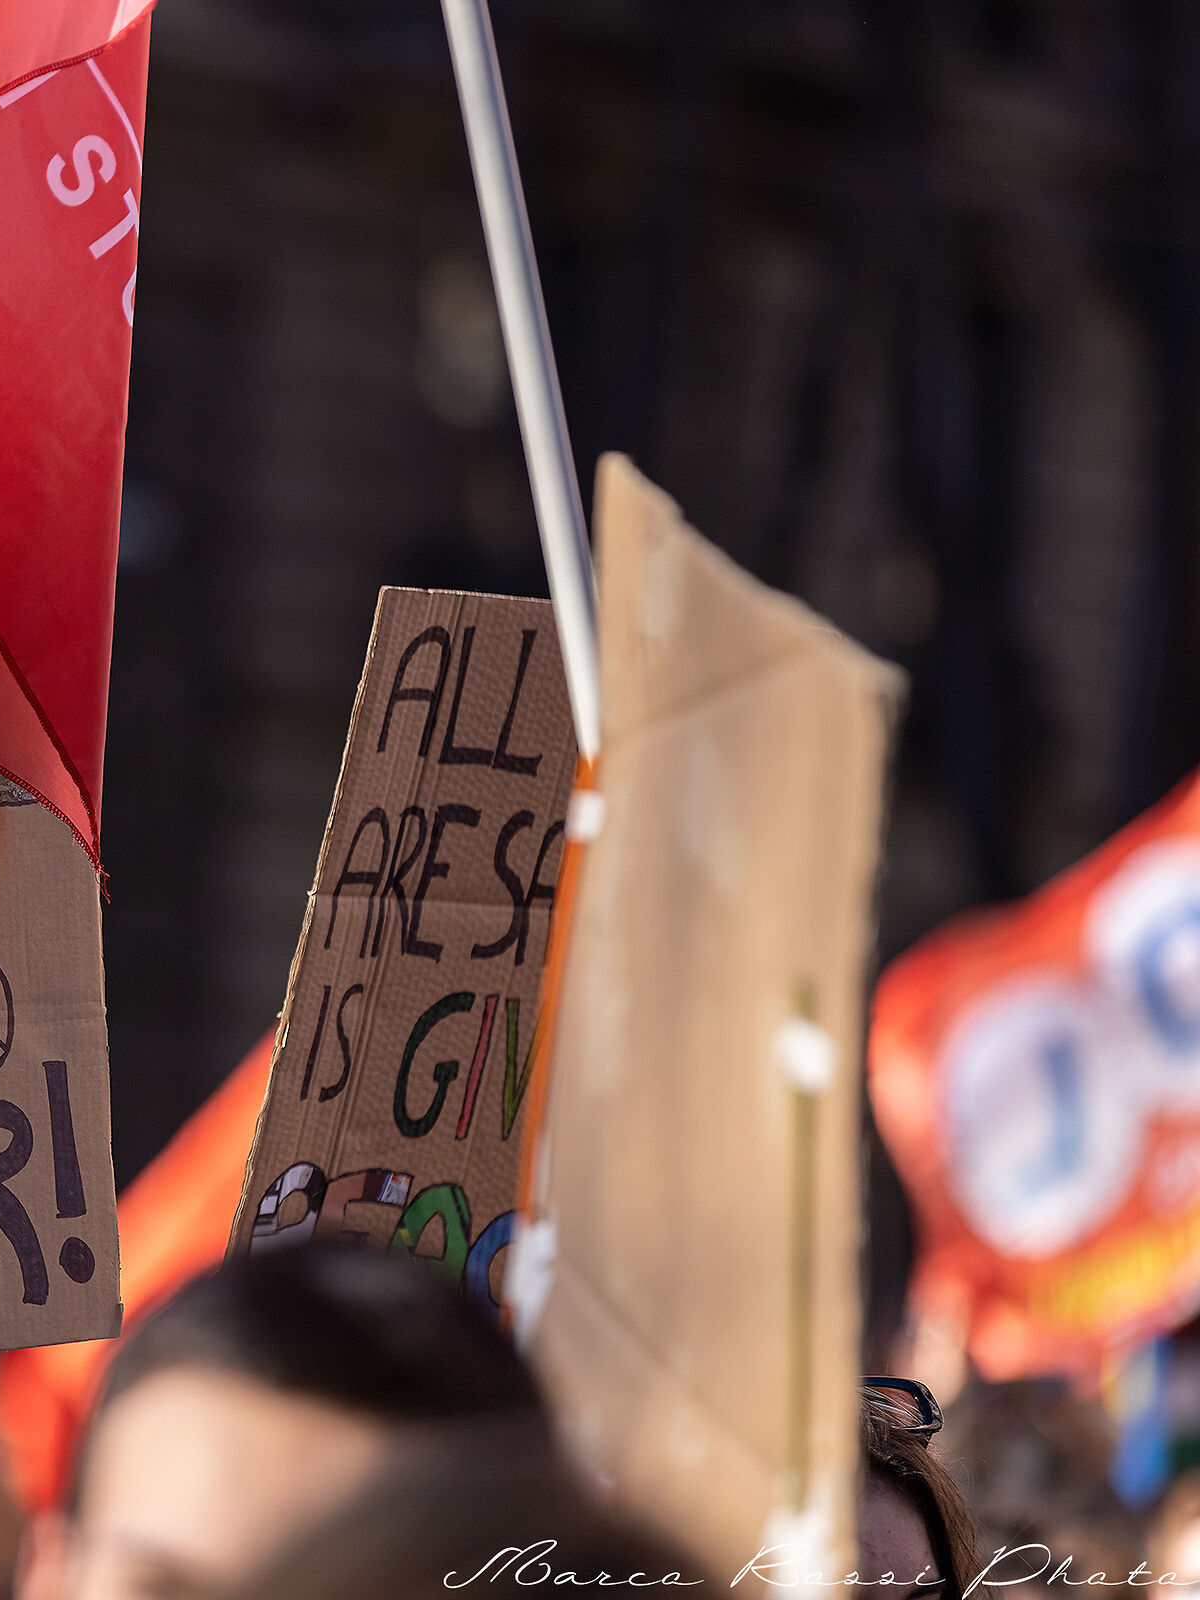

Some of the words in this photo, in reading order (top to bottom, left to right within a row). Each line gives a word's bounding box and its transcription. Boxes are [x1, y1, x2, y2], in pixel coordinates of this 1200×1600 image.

[377, 626, 543, 776] ALL
[325, 804, 481, 963] ARE
[301, 984, 364, 1102] IS
